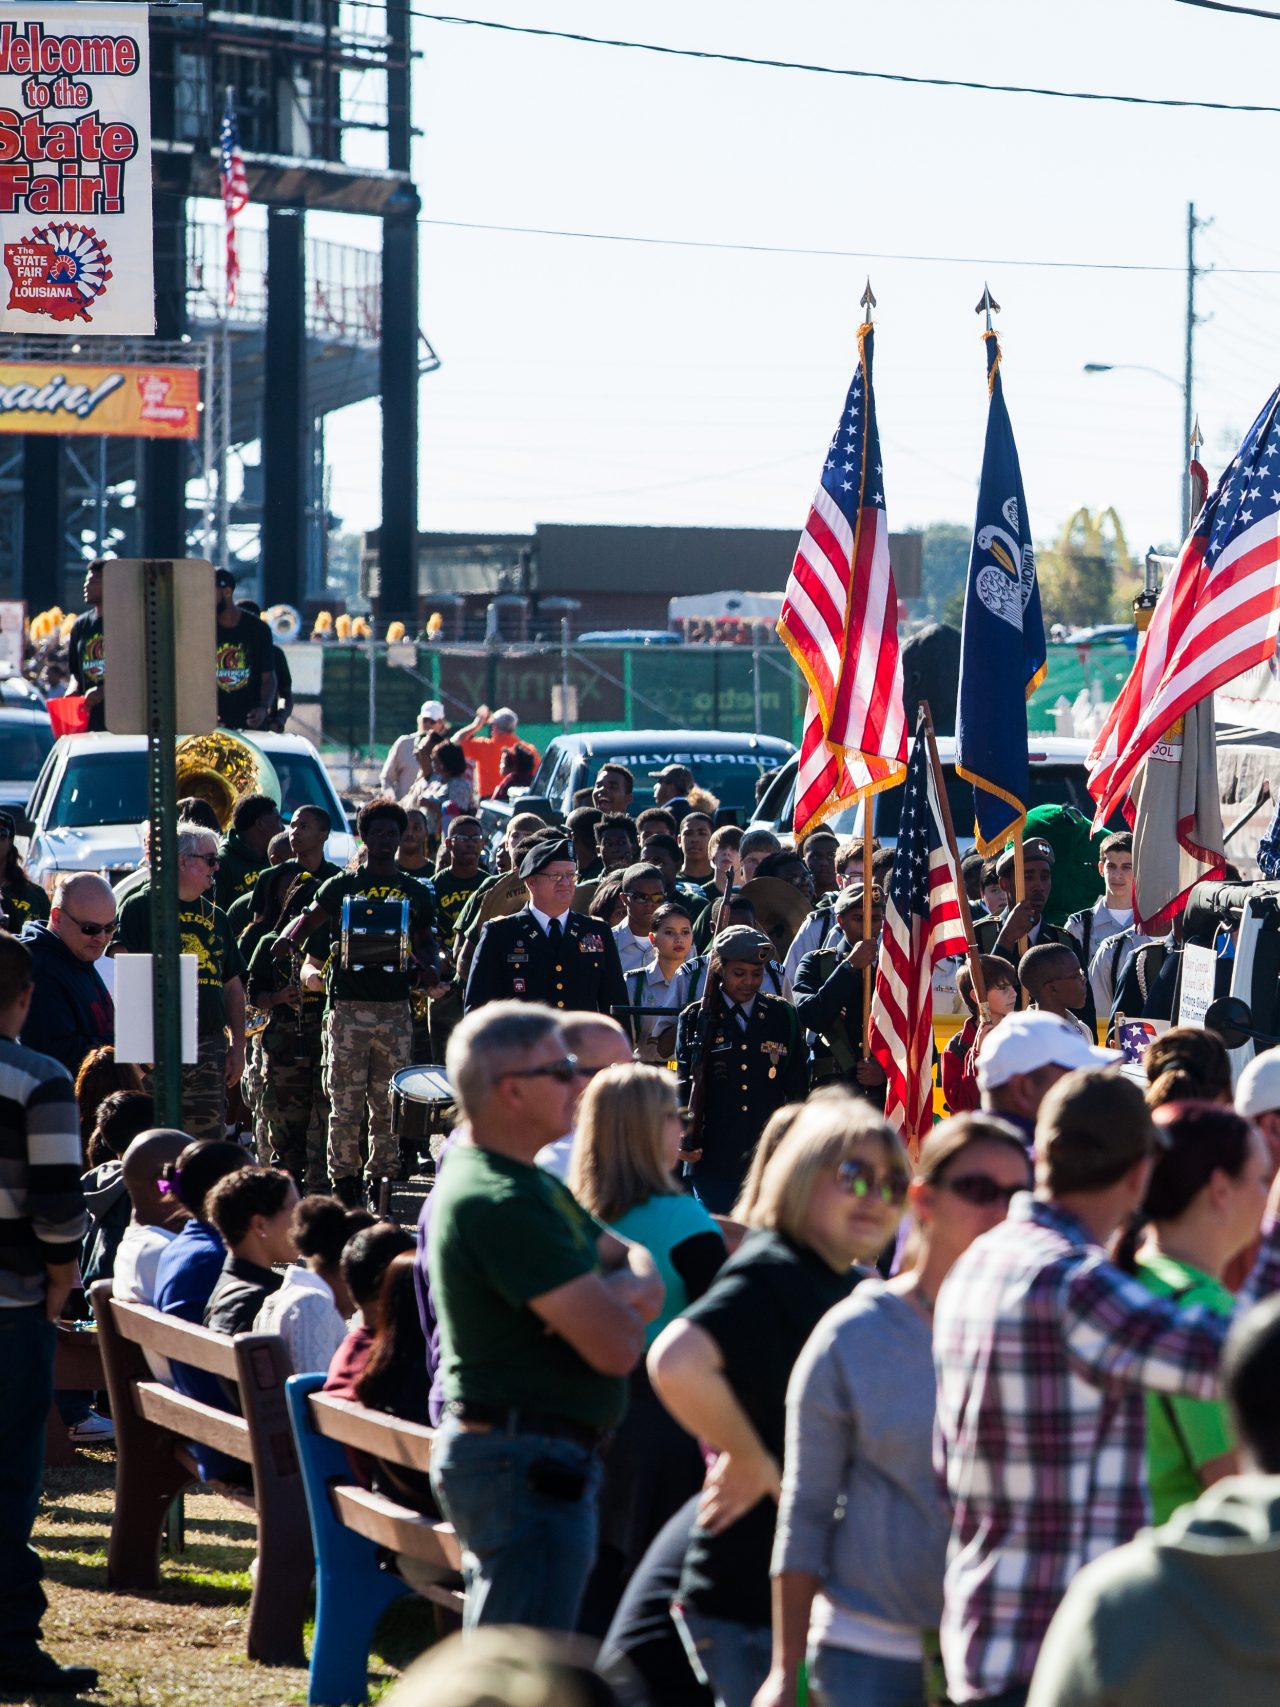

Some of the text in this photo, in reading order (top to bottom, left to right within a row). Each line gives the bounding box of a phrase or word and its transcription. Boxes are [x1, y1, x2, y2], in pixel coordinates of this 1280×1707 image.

[22, 74, 93, 109] to the
[0, 107, 138, 162] State
[0, 161, 125, 214] Fair!
[16, 246, 34, 254] The
[13, 255, 48, 267] STATE
[17, 266, 43, 278] FAIR
[21, 278, 33, 286] of
[14, 287, 73, 298] LOUISIANA
[0, 374, 125, 420] ain!
[609, 753, 777, 766] SILVERADO
